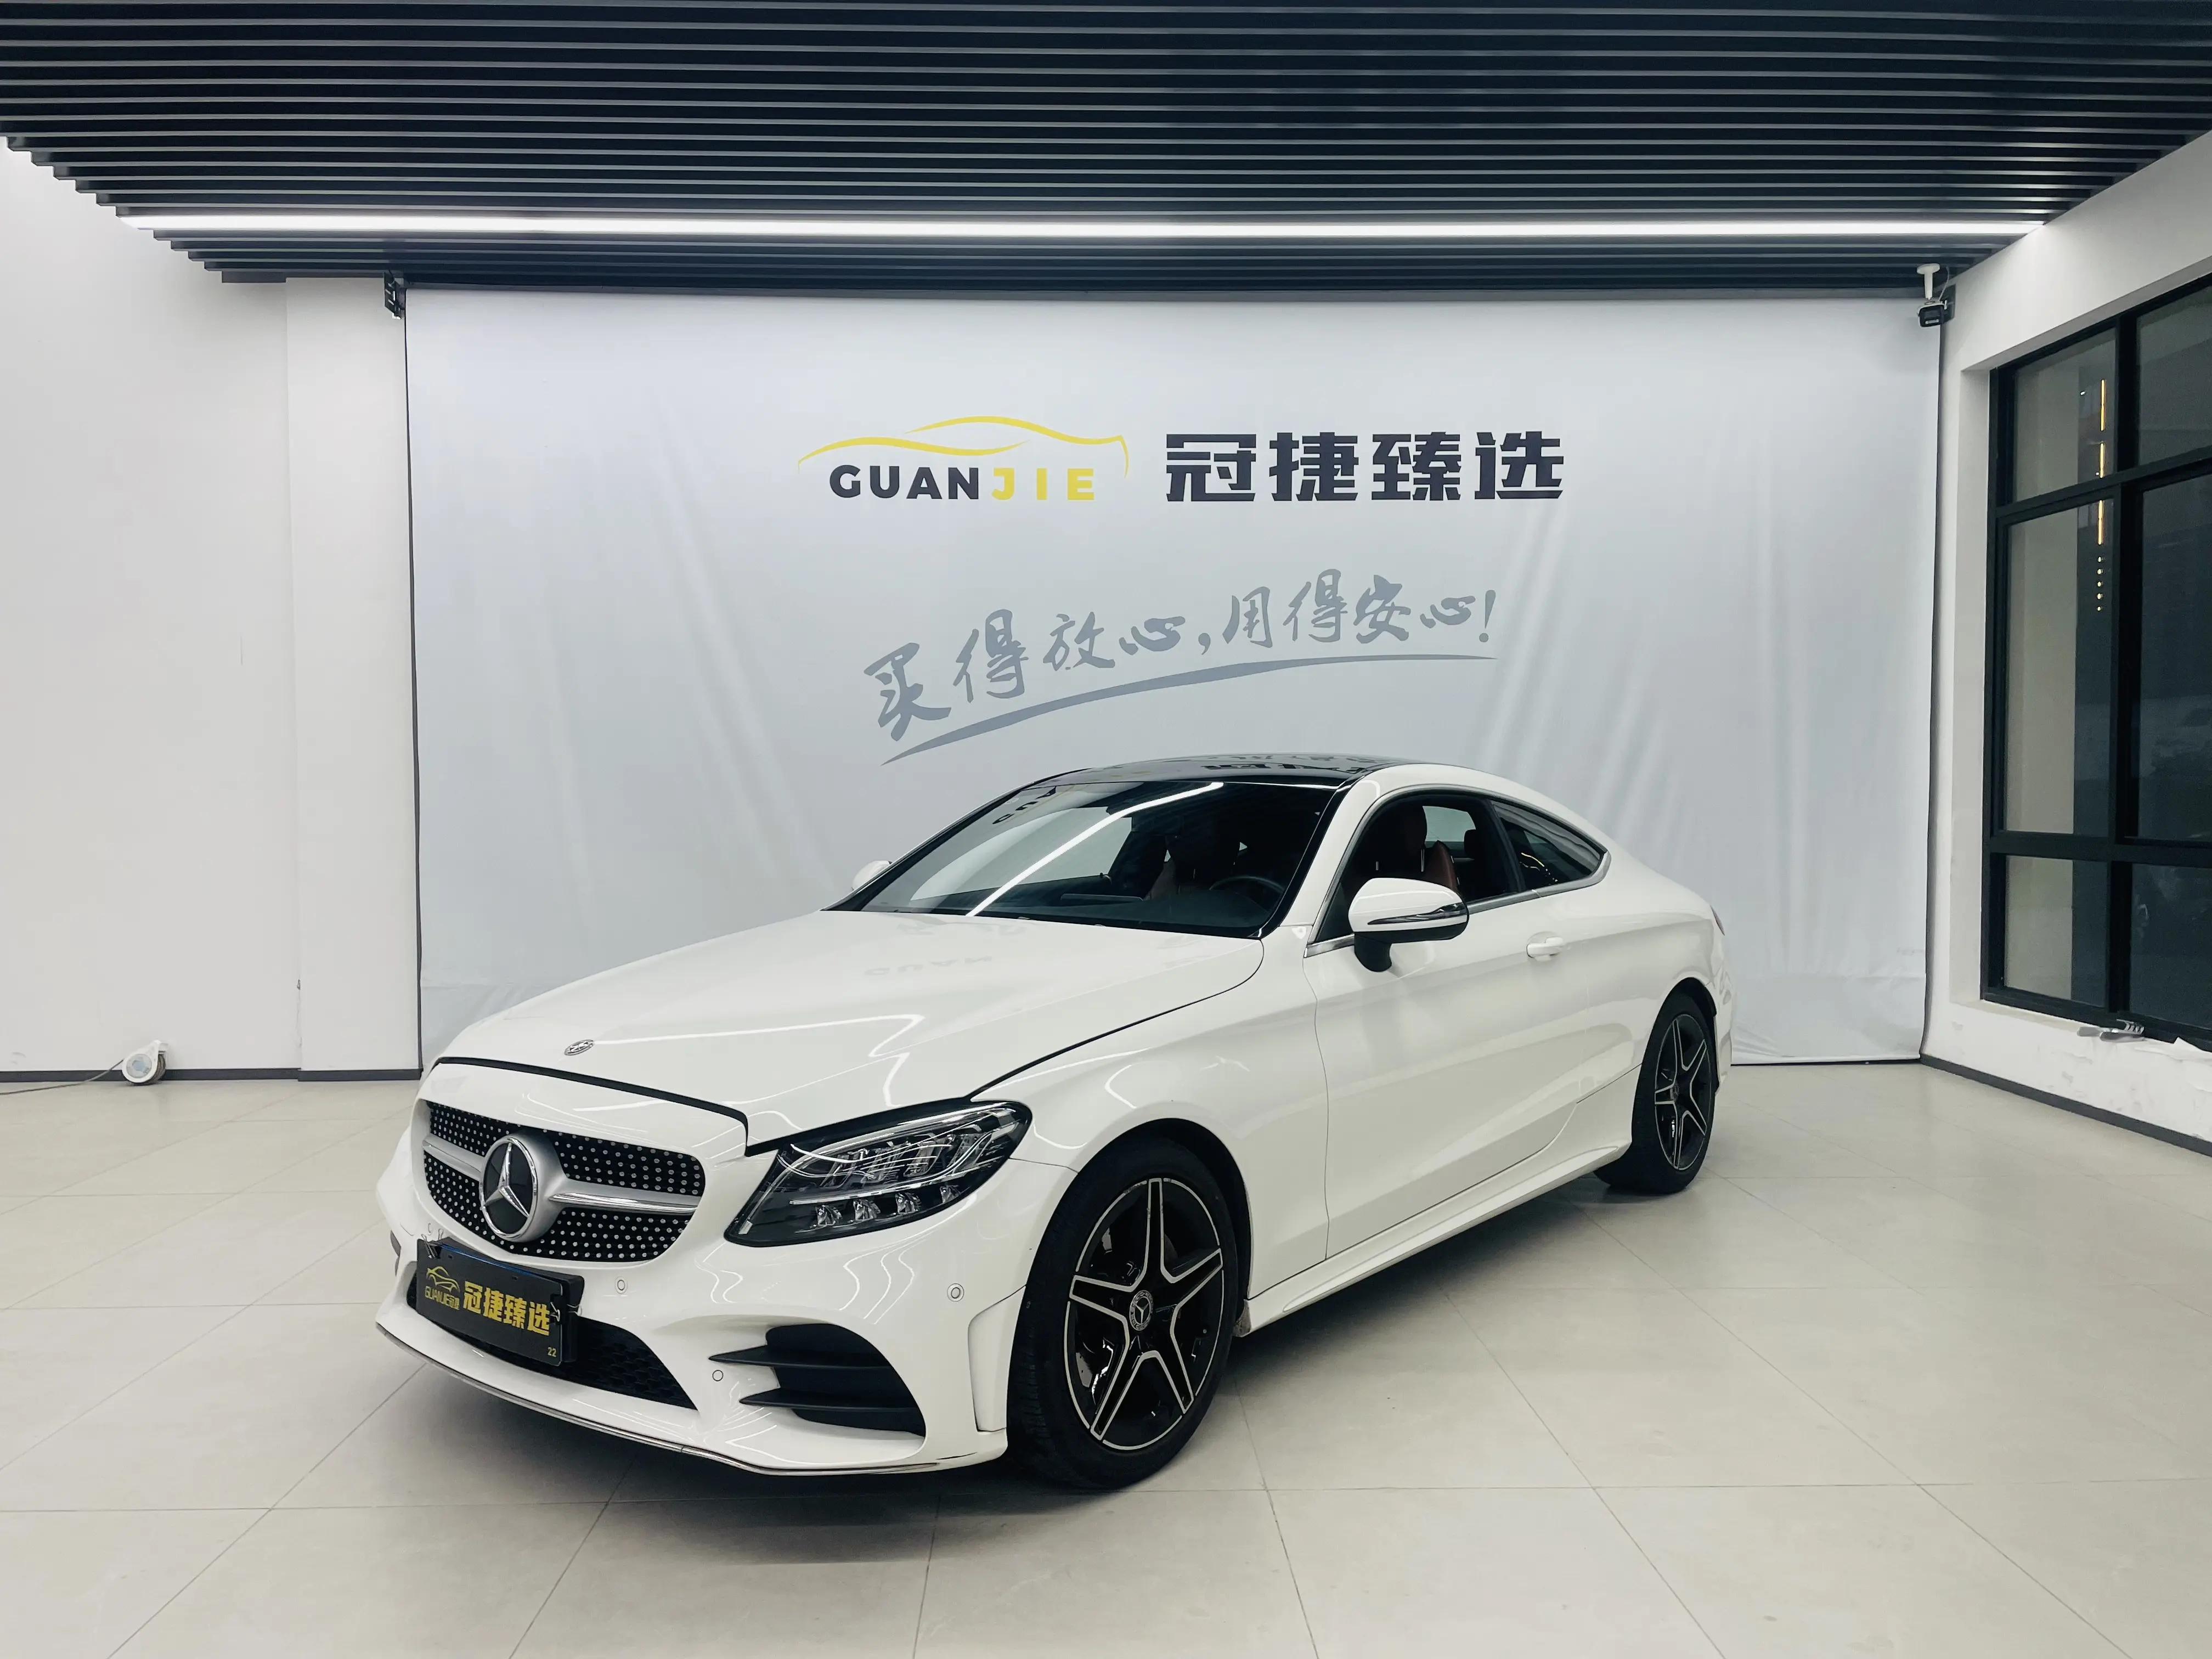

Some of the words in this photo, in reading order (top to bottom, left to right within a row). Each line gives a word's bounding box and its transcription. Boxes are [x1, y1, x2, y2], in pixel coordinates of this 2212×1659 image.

[1166, 431, 1564, 502] 冠捷臻选
[463, 1280, 550, 1336] 冠捷臻选
[548, 1347, 557, 1357] 22
